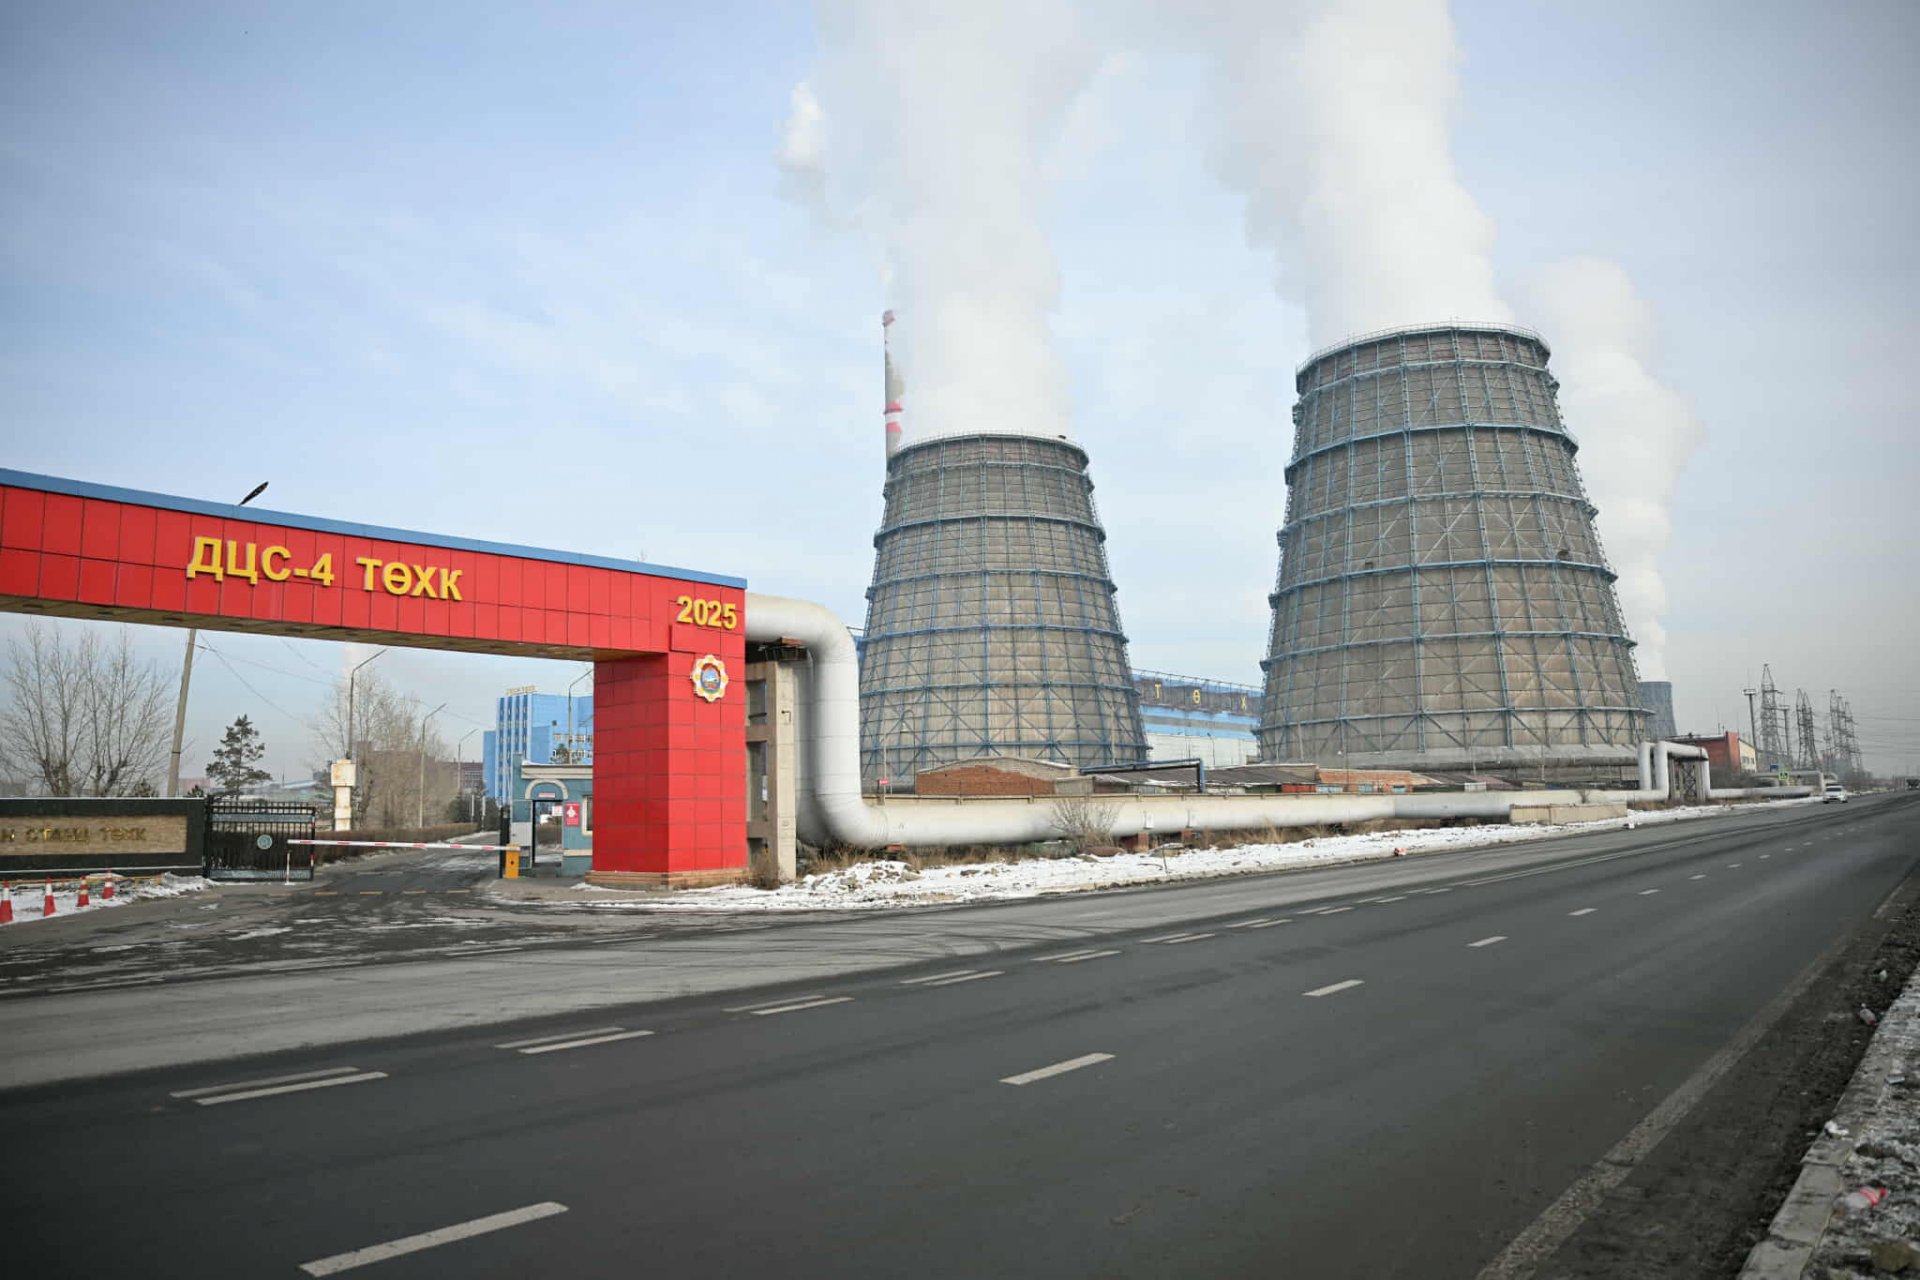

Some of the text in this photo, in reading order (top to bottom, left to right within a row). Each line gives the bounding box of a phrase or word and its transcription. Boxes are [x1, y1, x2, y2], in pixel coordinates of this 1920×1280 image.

[186, 536, 463, 601] ДЦС-4 ТӨХК
[676, 595, 737, 630] 2025
